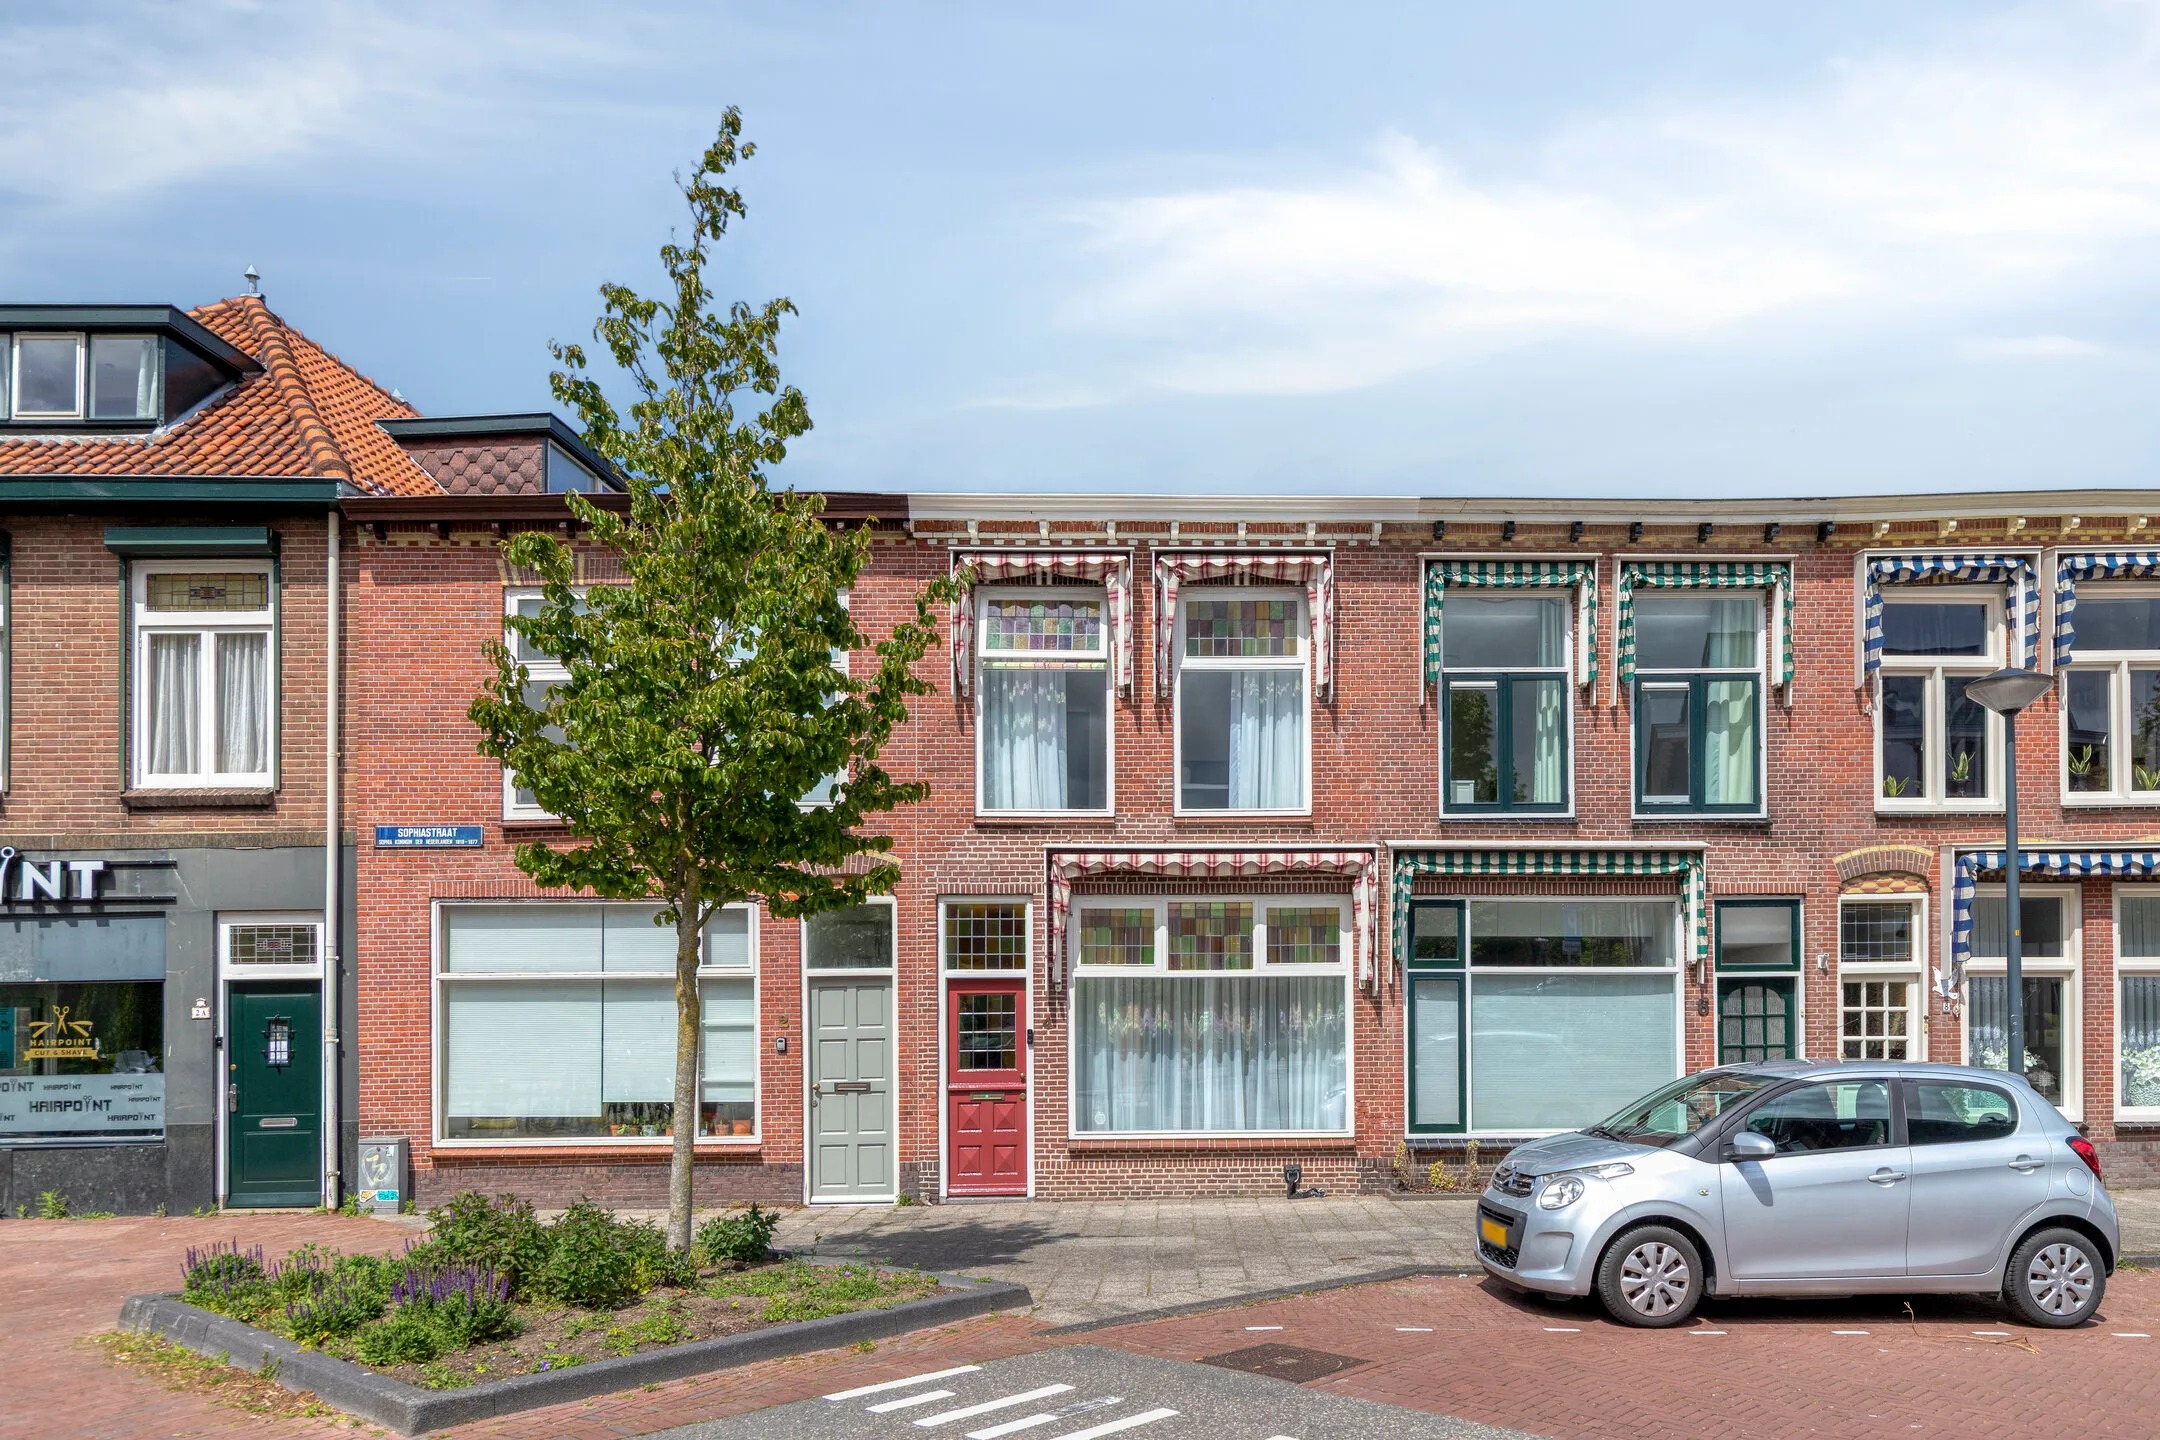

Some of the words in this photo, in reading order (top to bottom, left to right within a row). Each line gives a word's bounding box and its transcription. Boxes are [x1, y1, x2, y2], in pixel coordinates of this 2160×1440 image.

[397, 827, 458, 838] SOPHIASTRAAT
[1698, 997, 1710, 1017] 6
[778, 1014, 790, 1028] 2
[30, 1038, 93, 1047] HAIRPOINT
[0, 1079, 35, 1092] OINT
[29, 1095, 113, 1112] HAIRPOINT
[107, 1112, 156, 1121] HAIRPOINT
